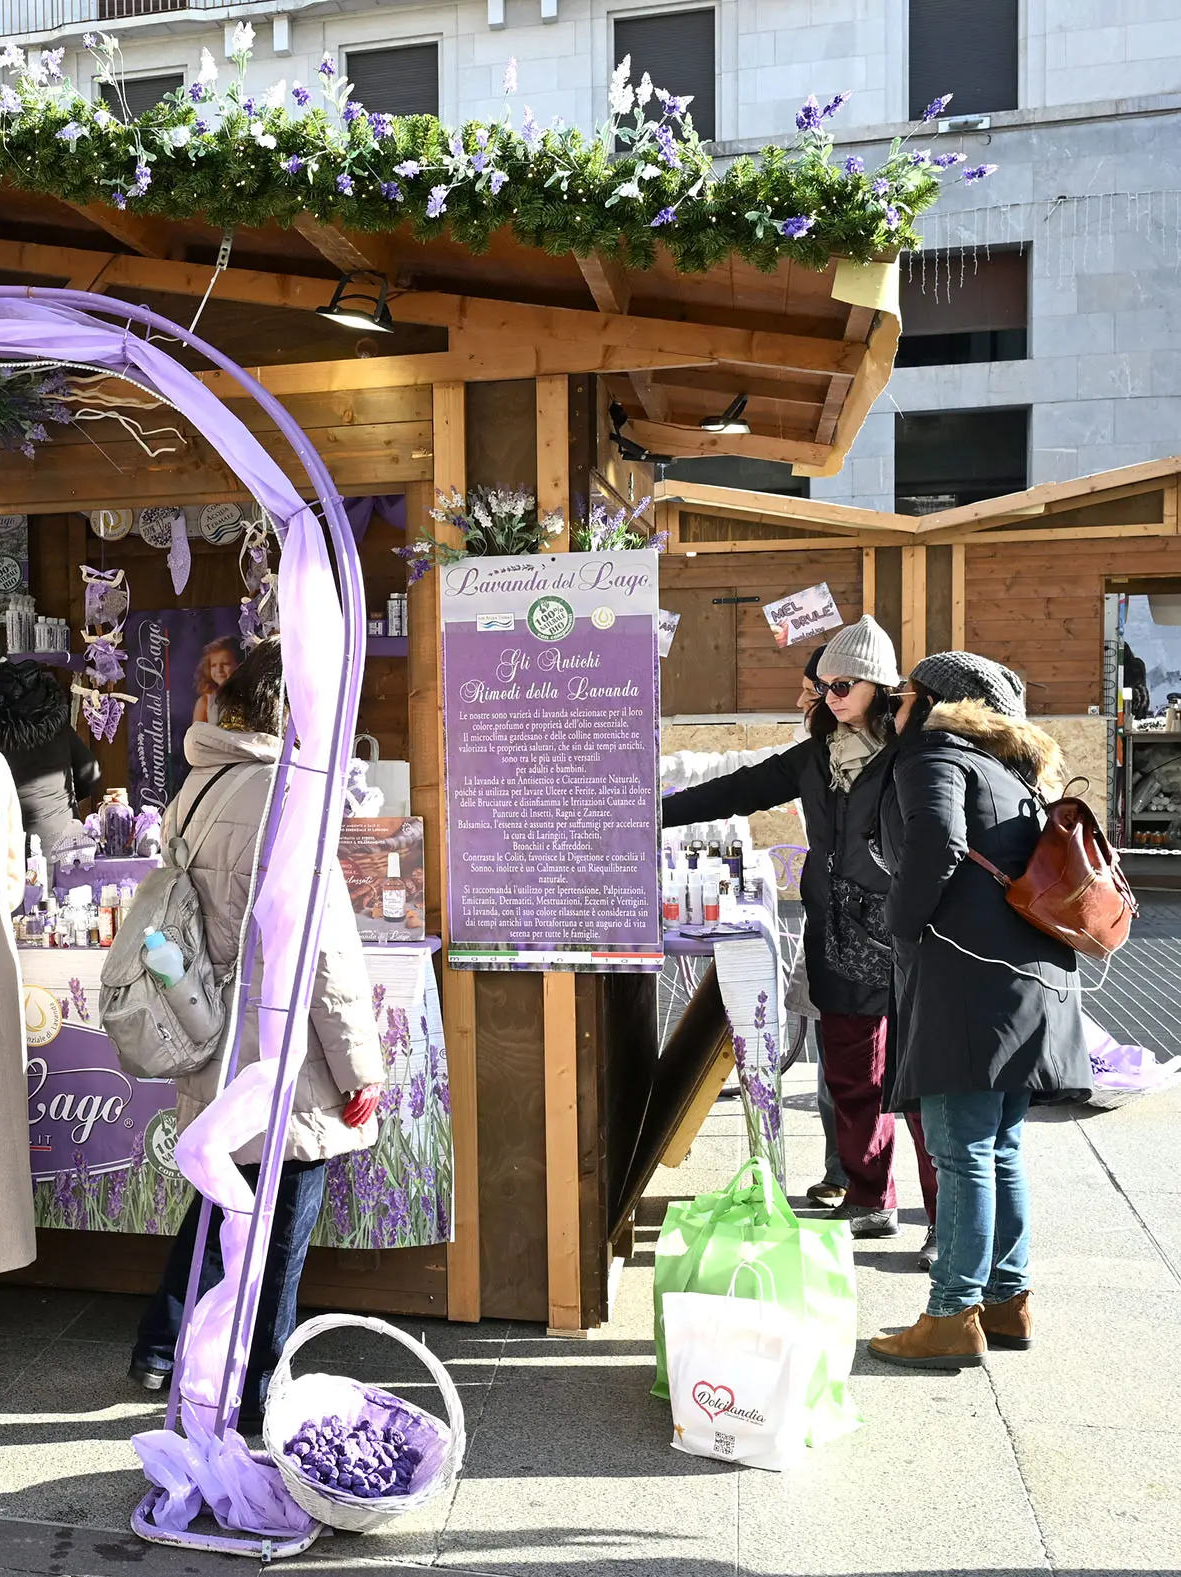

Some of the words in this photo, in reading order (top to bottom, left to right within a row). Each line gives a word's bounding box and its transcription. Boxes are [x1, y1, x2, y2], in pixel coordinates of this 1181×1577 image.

[207, 507, 230, 522] ACQUA
[2, 577, 16, 589] BIO
[445, 567, 549, 597] Lavanda
[552, 573, 575, 589] del
[579, 560, 651, 596] Lago
[535, 606, 564, 626] 100%
[771, 601, 803, 622] MEL
[548, 622, 565, 635] BIO
[135, 620, 171, 690] Lago
[496, 648, 531, 683] Gli
[537, 647, 601, 672] Antichi
[459, 680, 521, 704] Rimedi
[525, 682, 559, 700] della
[567, 676, 640, 701] Lavanda
[146, 693, 164, 717] del
[469, 711, 490, 719] nostre
[509, 710, 531, 719] varietà
[542, 709, 567, 718] lavanda
[570, 708, 606, 718] selezionate
[608, 710, 619, 719] per
[628, 708, 642, 716] loro
[531, 720, 562, 731] proprietà
[564, 719, 592, 728] dell'olio
[593, 718, 628, 728] essenziale.
[470, 732, 507, 741] microclima
[509, 731, 542, 743] gardesano
[550, 731, 566, 740] delle
[567, 731, 591, 740] colline
[593, 730, 629, 739] moreniche
[459, 743, 486, 752] valorizza
[496, 742, 527, 754] proprietà
[529, 742, 556, 752] salutari,
[557, 742, 569, 751] che
[571, 742, 581, 751] sin
[583, 742, 594, 750] dai
[596, 742, 616, 752] tempi
[141, 717, 169, 812] Lavanda
[538, 753, 550, 764] più
[552, 753, 566, 762] utili
[573, 753, 600, 762] versatili
[516, 768, 526, 776] per
[528, 765, 548, 774] adulti
[556, 764, 586, 774] bambini.
[474, 776, 499, 785] lavanda
[517, 775, 554, 784] Antisettico
[561, 775, 606, 784] Cicatrizzante
[454, 788, 476, 799] poiché
[485, 787, 509, 796] utilizza
[511, 790, 521, 798] per
[523, 787, 542, 796] lavare
[545, 787, 567, 796] Ulcere
[574, 786, 596, 796] Ferite,
[598, 786, 620, 795] allevia
[628, 786, 652, 795] dolore
[460, 798, 475, 807] delle
[477, 798, 512, 807] Bruciature
[519, 798, 560, 807] disinfiamma
[570, 797, 604, 806] Irritazioni
[606, 797, 635, 806] Cutanee
[492, 809, 518, 818] Punture
[530, 809, 553, 819] Insetti,
[555, 809, 575, 820] Ragni
[583, 808, 612, 817] Zanzare.
[458, 820, 492, 830] Balsamica,
[494, 820, 522, 829] l'essenza
[556, 822, 566, 830] per
[569, 819, 600, 830] suffumigi
[602, 822, 613, 830] per
[616, 819, 649, 828] accelerare
[536, 831, 567, 842] Laringiti,
[513, 842, 544, 851] Bronchiti
[552, 842, 592, 851] Raffreddori.
[462, 853, 494, 862] Contrasta
[504, 853, 526, 863] Coliti,
[528, 853, 557, 862] favorisce
[567, 853, 603, 864] Digestione
[611, 853, 638, 861] concilia
[496, 864, 518, 873] inoltre
[536, 864, 569, 873] Calmante
[588, 864, 637, 874] Riequilibrante
[346, 875, 373, 885] ilassati
[538, 875, 568, 884] naturale.
[472, 886, 511, 894] raccomanda
[513, 886, 542, 894] l'utilizzo
[544, 888, 554, 896] per
[603, 886, 645, 896] Palpitazioni,
[462, 896, 496, 906] Emicrania,
[499, 896, 533, 906] Dermatiti,
[536, 896, 582, 906] Mestruazioni,
[584, 897, 608, 906] Eczemi
[616, 897, 648, 908] Vertigini.
[472, 907, 500, 917] lavanda,
[536, 907, 557, 916] colore
[558, 908, 589, 916] rilassante
[597, 908, 635, 917] considerata
[638, 908, 647, 917] sin
[465, 918, 475, 927] dai
[477, 918, 496, 929] tempi
[499, 918, 521, 927] antichi
[535, 918, 576, 928] Portafortuna
[596, 919, 622, 930] augurio
[633, 919, 645, 928] vita
[532, 932, 542, 940] per
[570, 930, 599, 941] famiglie.
[26, 1036, 46, 1044] nziale
[49, 1002, 59, 1030] Lavanda
[29, 1057, 133, 1143] Lago
[159, 1166, 174, 1177] con
[697, 1391, 767, 1423] Dolcilandia
